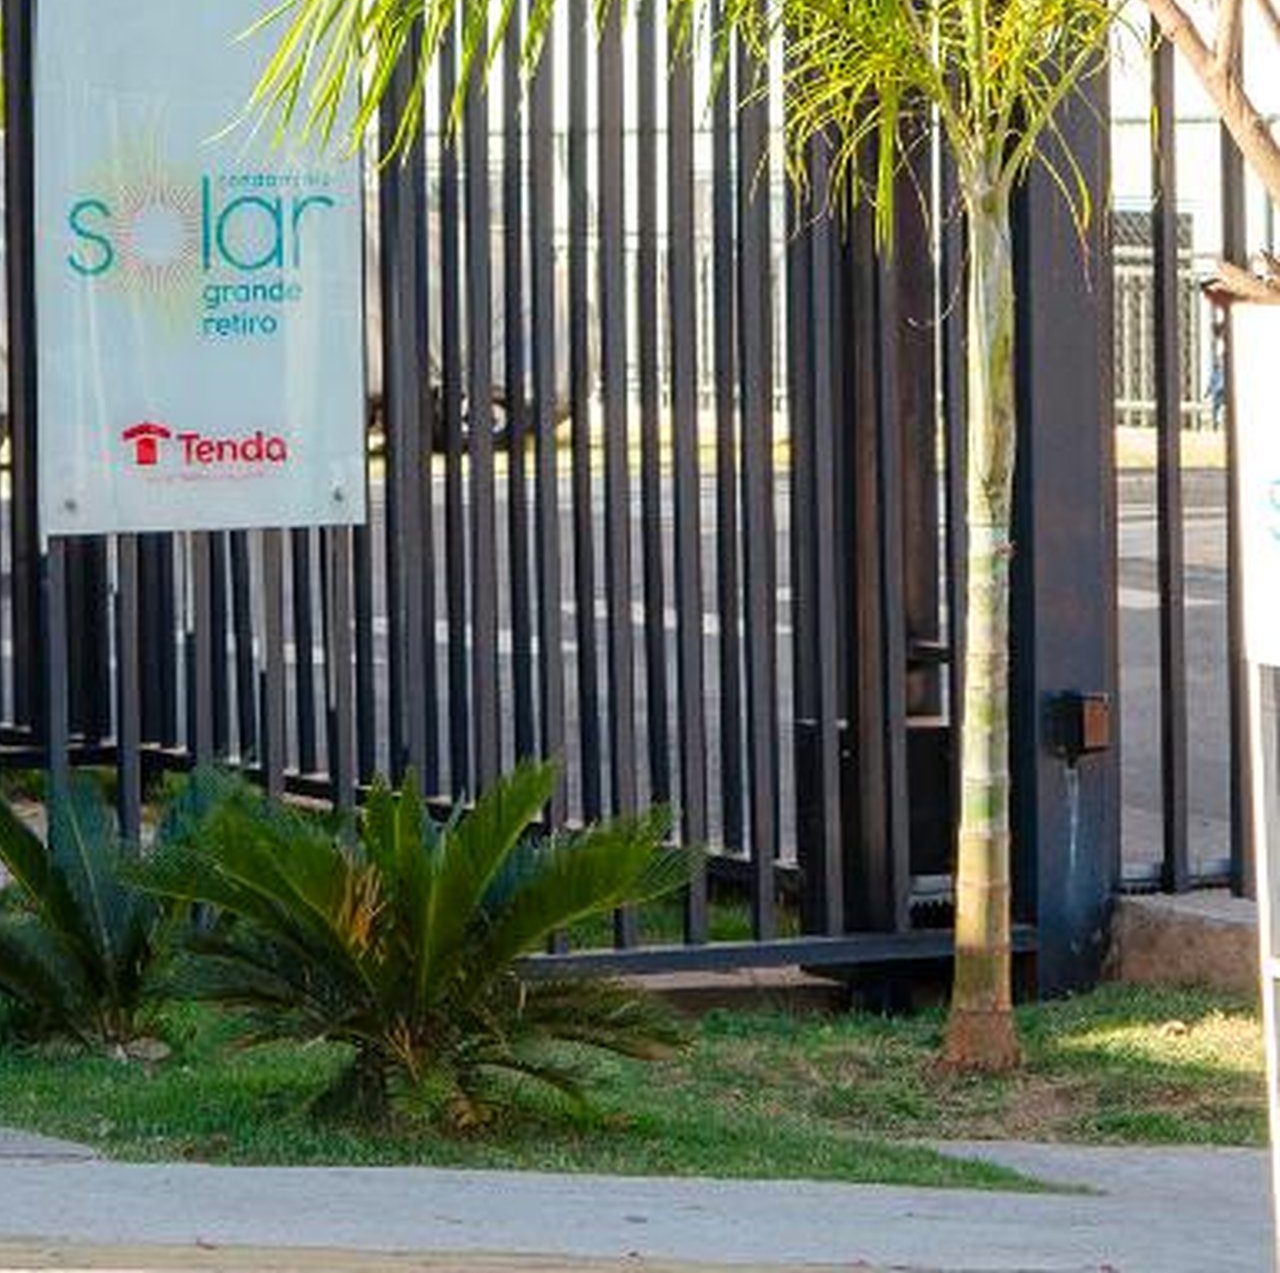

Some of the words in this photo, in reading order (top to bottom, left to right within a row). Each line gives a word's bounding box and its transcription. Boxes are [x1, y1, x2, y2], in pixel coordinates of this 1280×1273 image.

[203, 281, 302, 309] grande
[203, 312, 277, 334] retiro
[178, 431, 287, 464] Tenda
